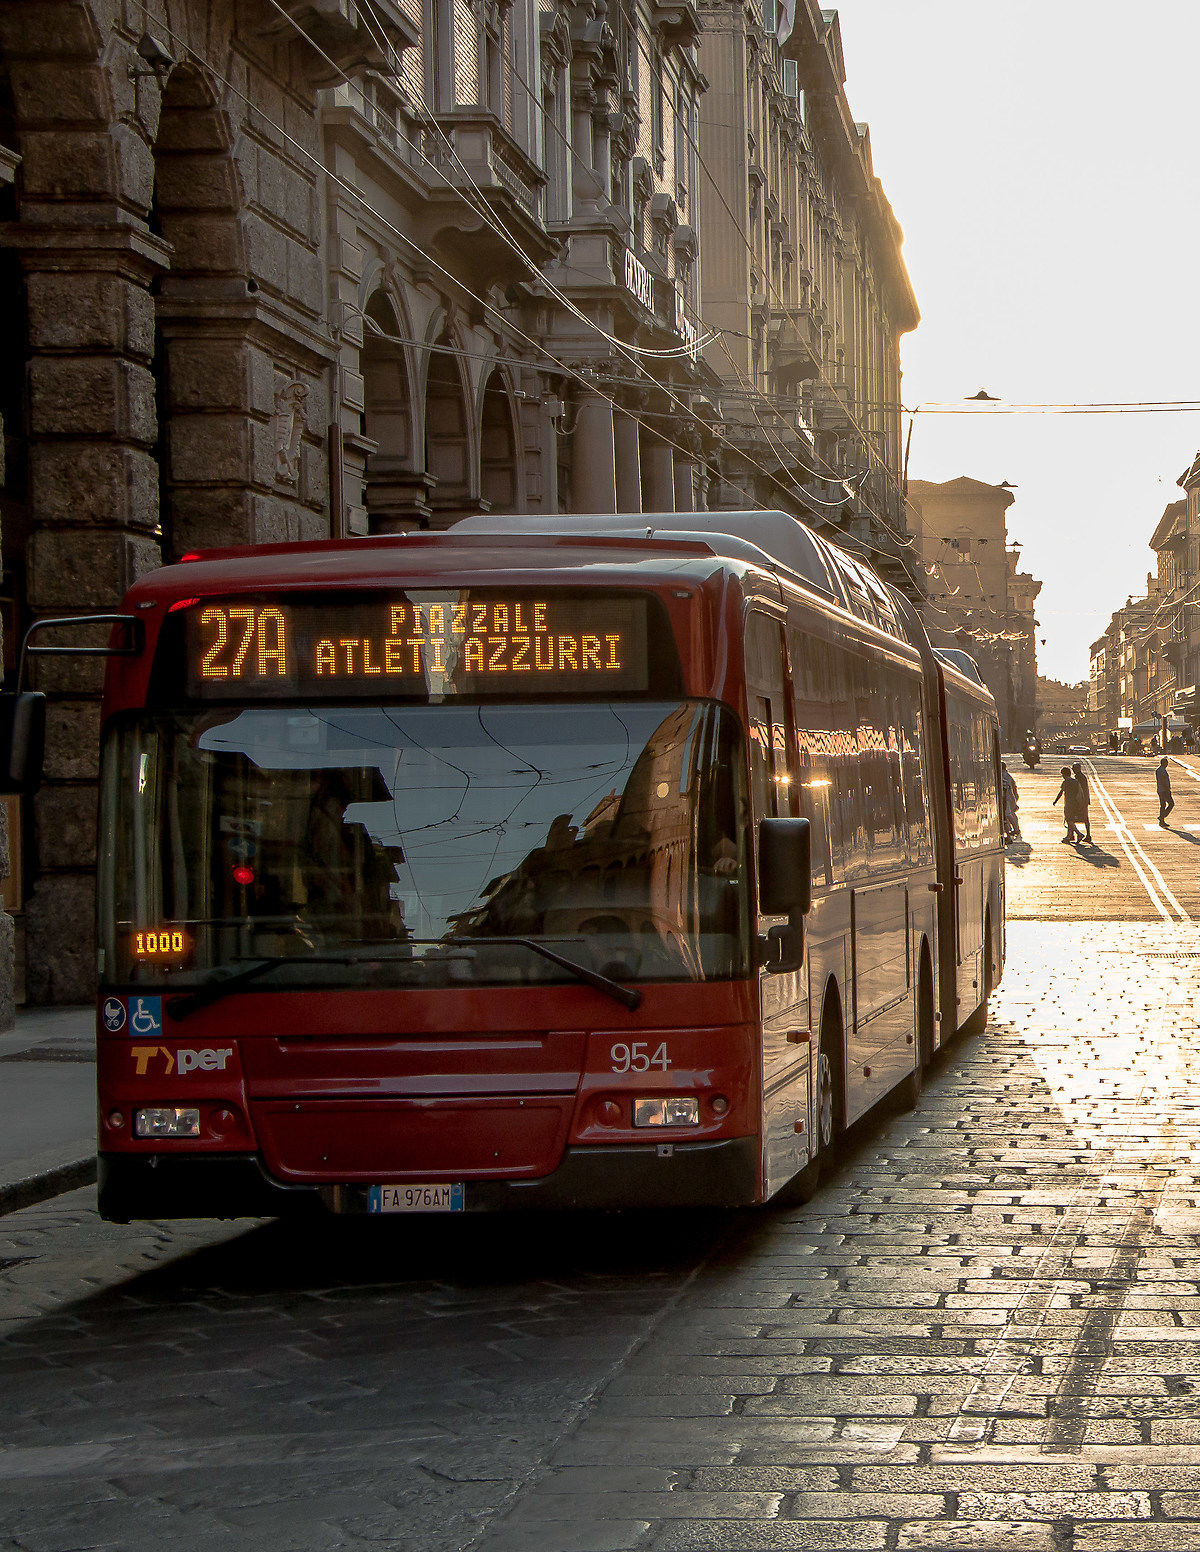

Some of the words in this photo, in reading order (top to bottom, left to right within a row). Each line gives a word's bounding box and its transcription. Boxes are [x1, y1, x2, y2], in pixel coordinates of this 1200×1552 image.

[201, 608, 287, 677] 27A
[390, 603, 547, 635] PIAZZALE
[316, 638, 447, 675] ATLETI
[464, 634, 621, 671] AZZURRI
[136, 932, 184, 953] 1000
[610, 1042, 672, 1074] 954
